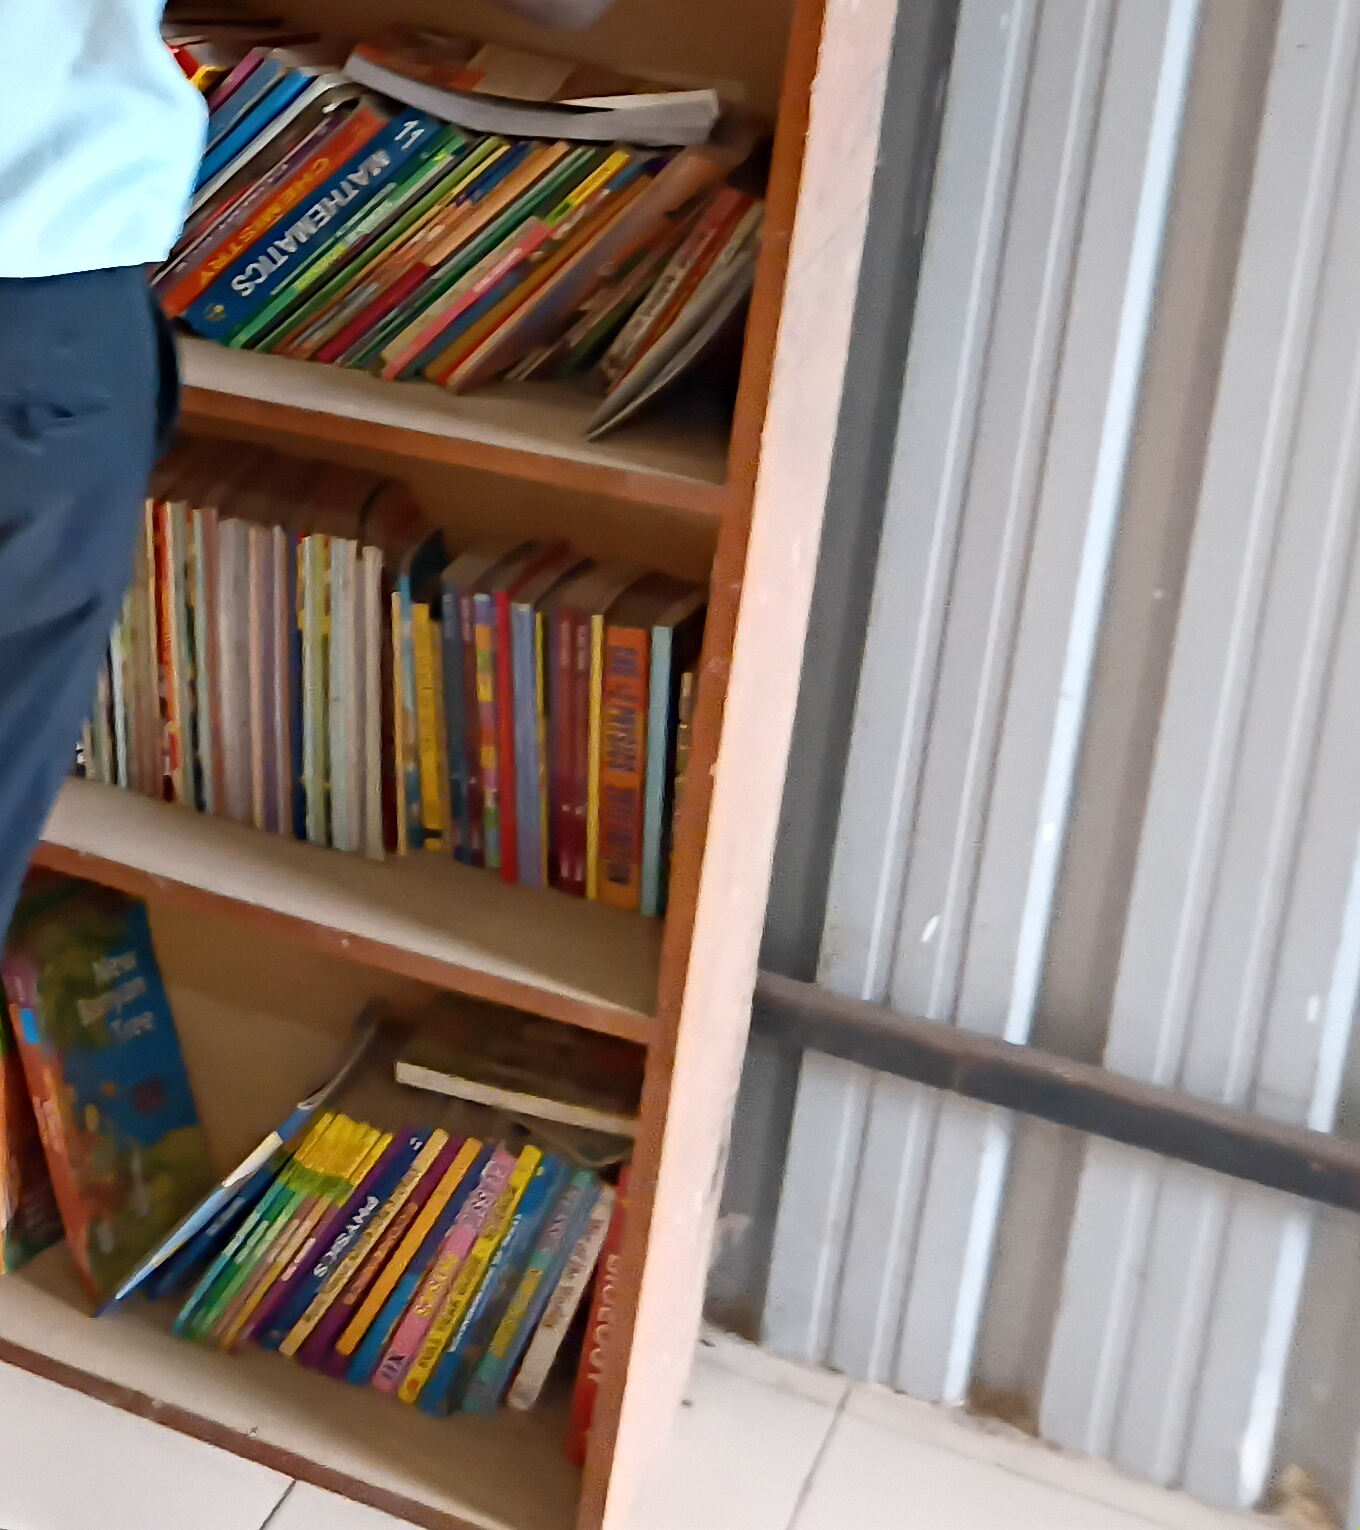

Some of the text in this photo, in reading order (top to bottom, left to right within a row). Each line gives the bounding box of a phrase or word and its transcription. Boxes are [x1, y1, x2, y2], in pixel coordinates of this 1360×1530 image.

[201, 157, 330, 286] CHEMISTRY
[231, 149, 390, 297] MATHEMATICS
[313, 1195, 379, 1277] PHYSICS
